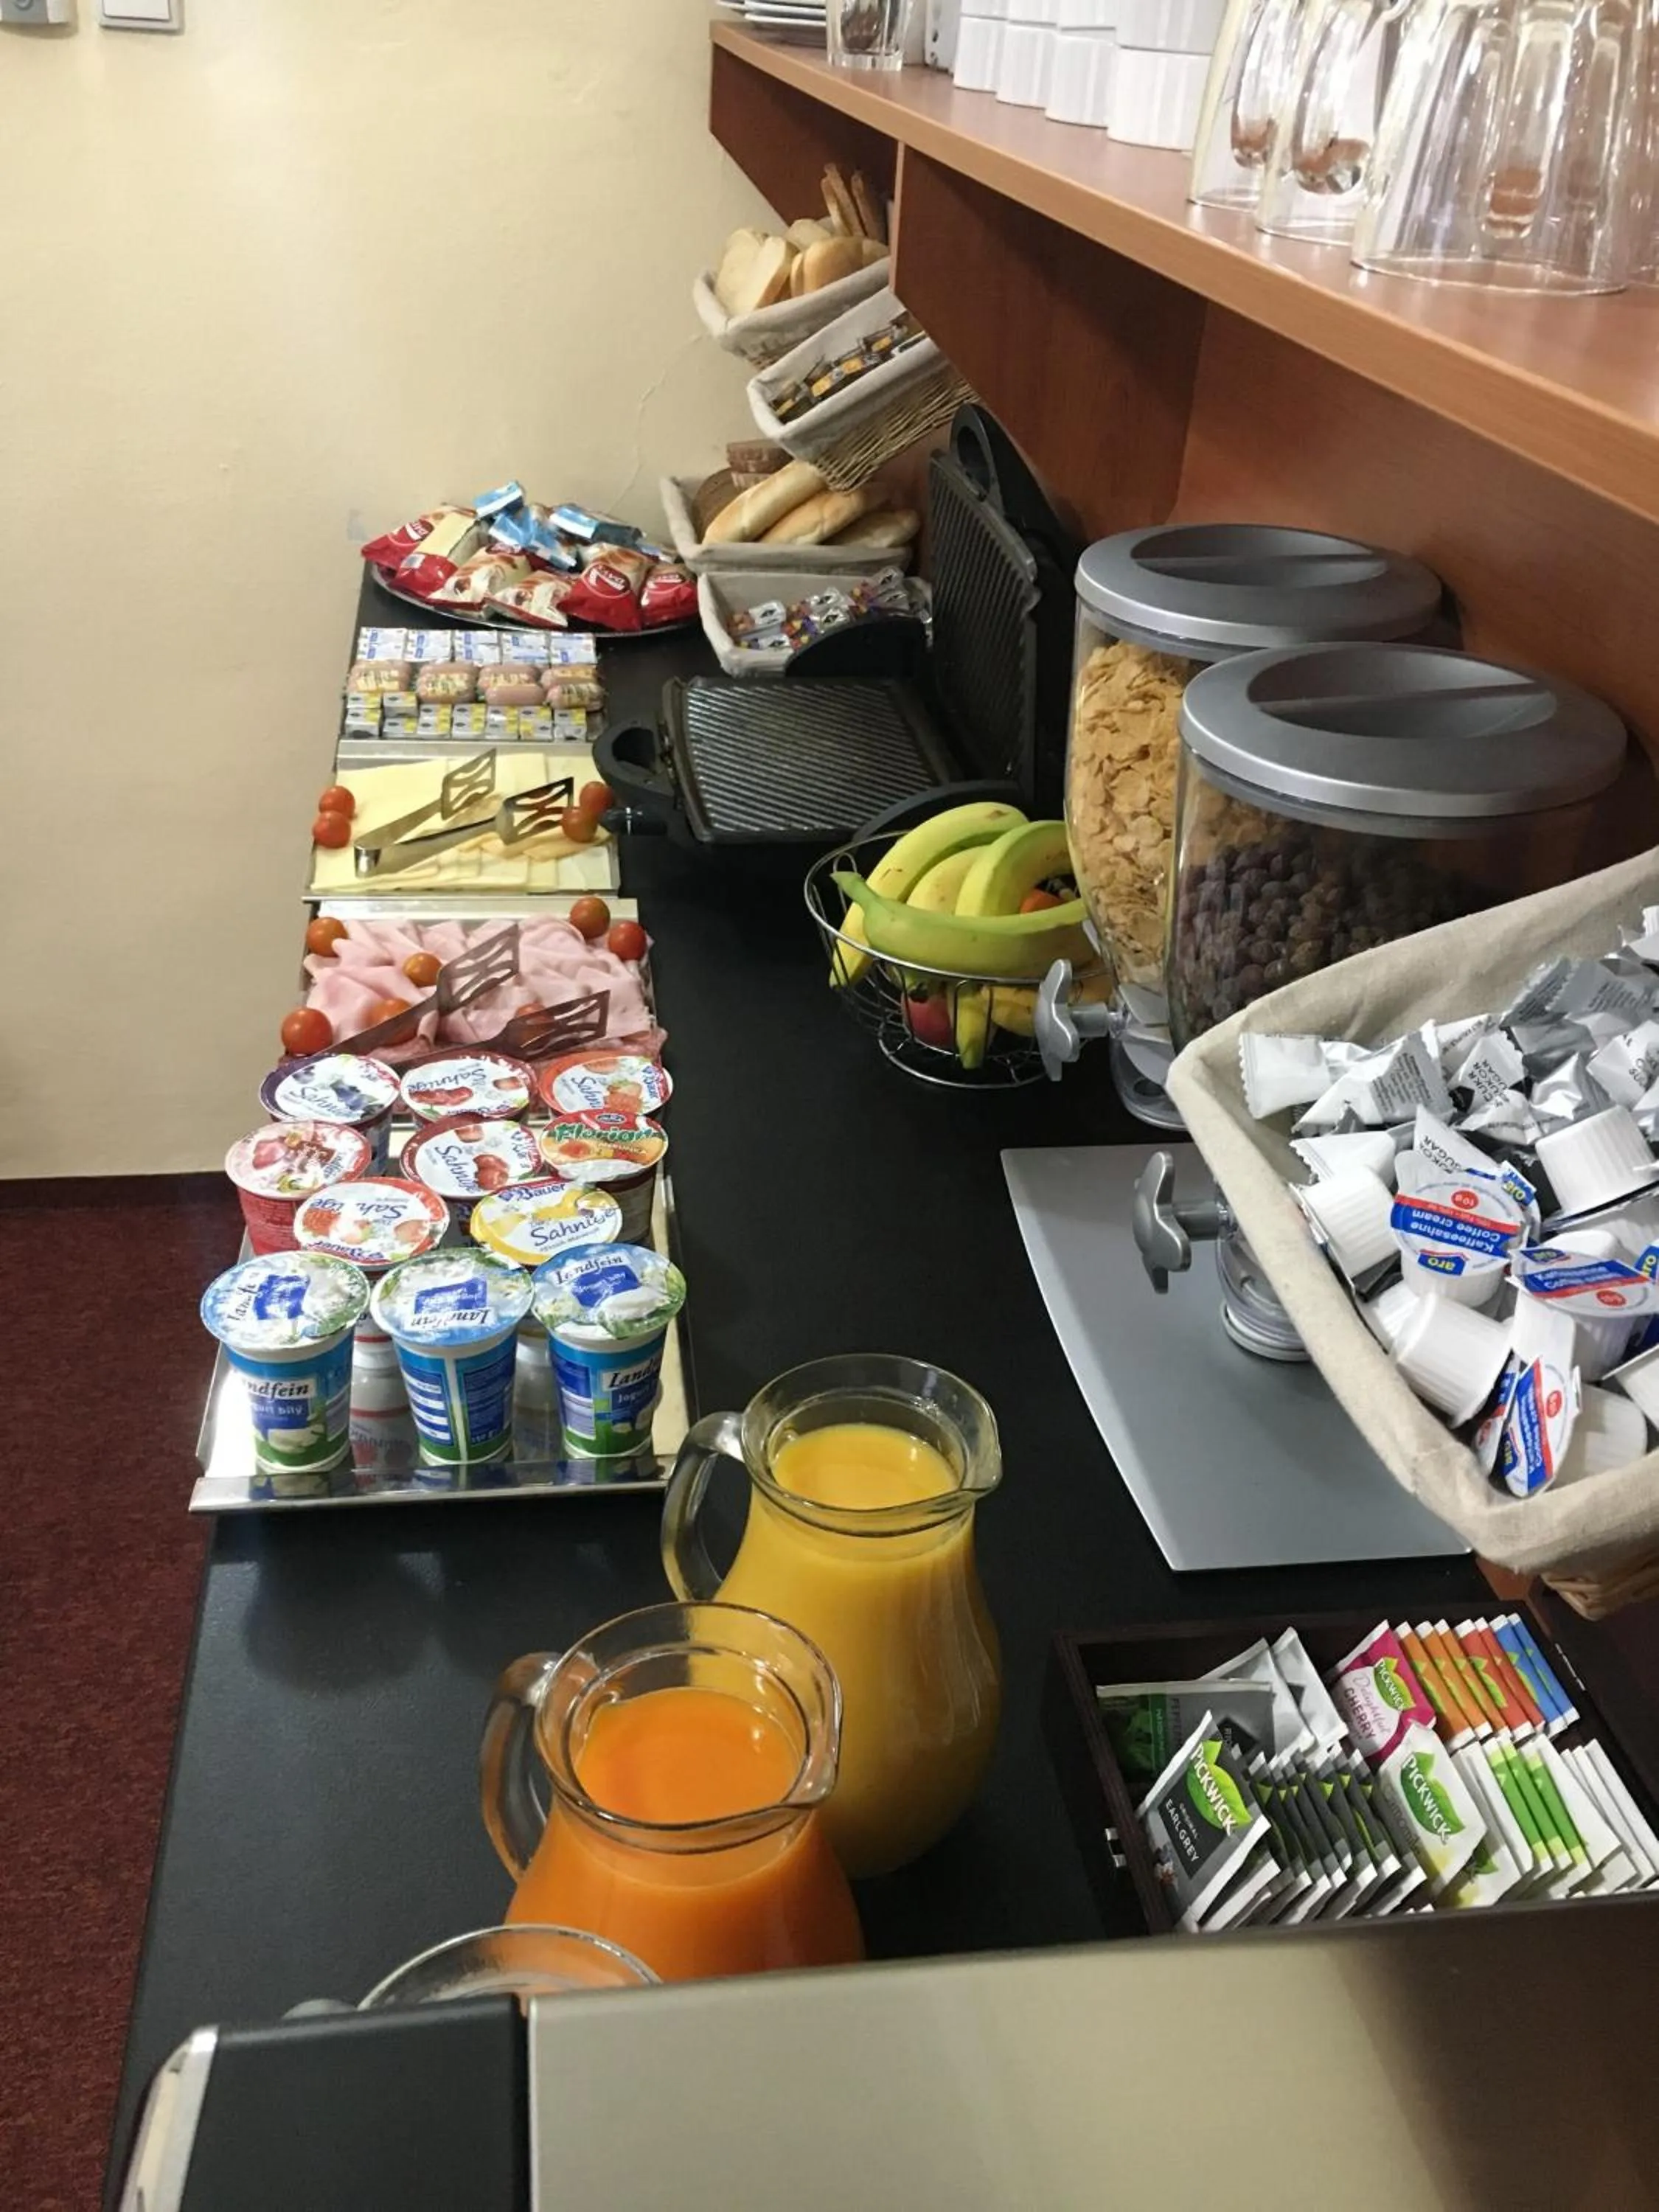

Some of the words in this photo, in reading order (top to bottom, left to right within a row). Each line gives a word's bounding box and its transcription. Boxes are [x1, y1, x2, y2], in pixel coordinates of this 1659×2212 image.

[530, 1206, 617, 1247] Sahnige
[1411, 1209, 1453, 1228] cream
[1456, 1222, 1501, 1243] Coffee
[1410, 1222, 1495, 1253] Kaffeesahne
[1427, 1256, 1457, 1270] aro
[246, 1380, 310, 1400] ndfein
[1344, 1687, 1377, 1739] CHERRY
[1191, 1744, 1237, 1837] PICKWICK
[1402, 1755, 1452, 1846] PICKWICK
[1165, 1798, 1181, 1831] EARL
[1179, 1829, 1200, 1863] GREY
